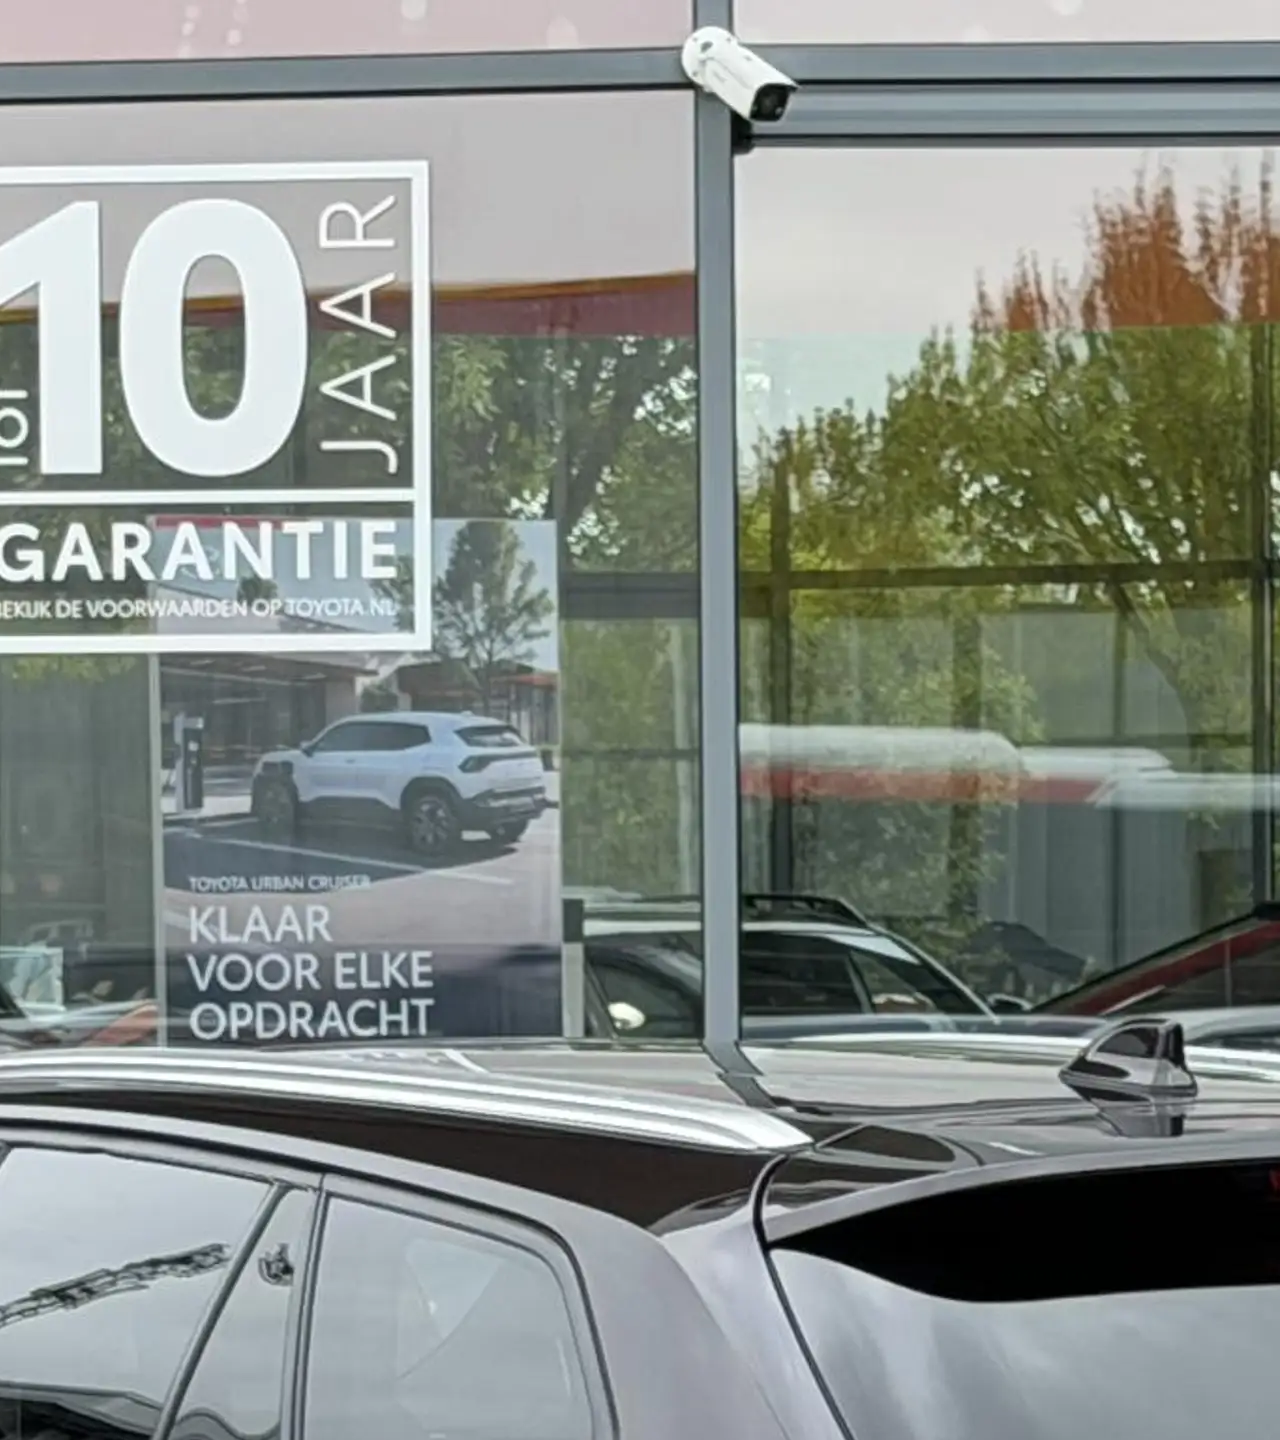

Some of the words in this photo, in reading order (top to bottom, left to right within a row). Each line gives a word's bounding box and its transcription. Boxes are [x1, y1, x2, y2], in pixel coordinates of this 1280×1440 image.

[319, 195, 397, 475] JAAR
[54, 599, 84, 619] DE
[85, 598, 248, 618] VOORWAARDEN
[250, 598, 282, 617] OP
[188, 875, 250, 892] TOYOTA
[251, 874, 305, 890] URBAN
[307, 873, 371, 890] CRUISER
[189, 905, 333, 944] KLAAR
[186, 953, 321, 993] VOOR
[334, 951, 435, 989] ELKE
[189, 998, 435, 1040] OPDRACHT
